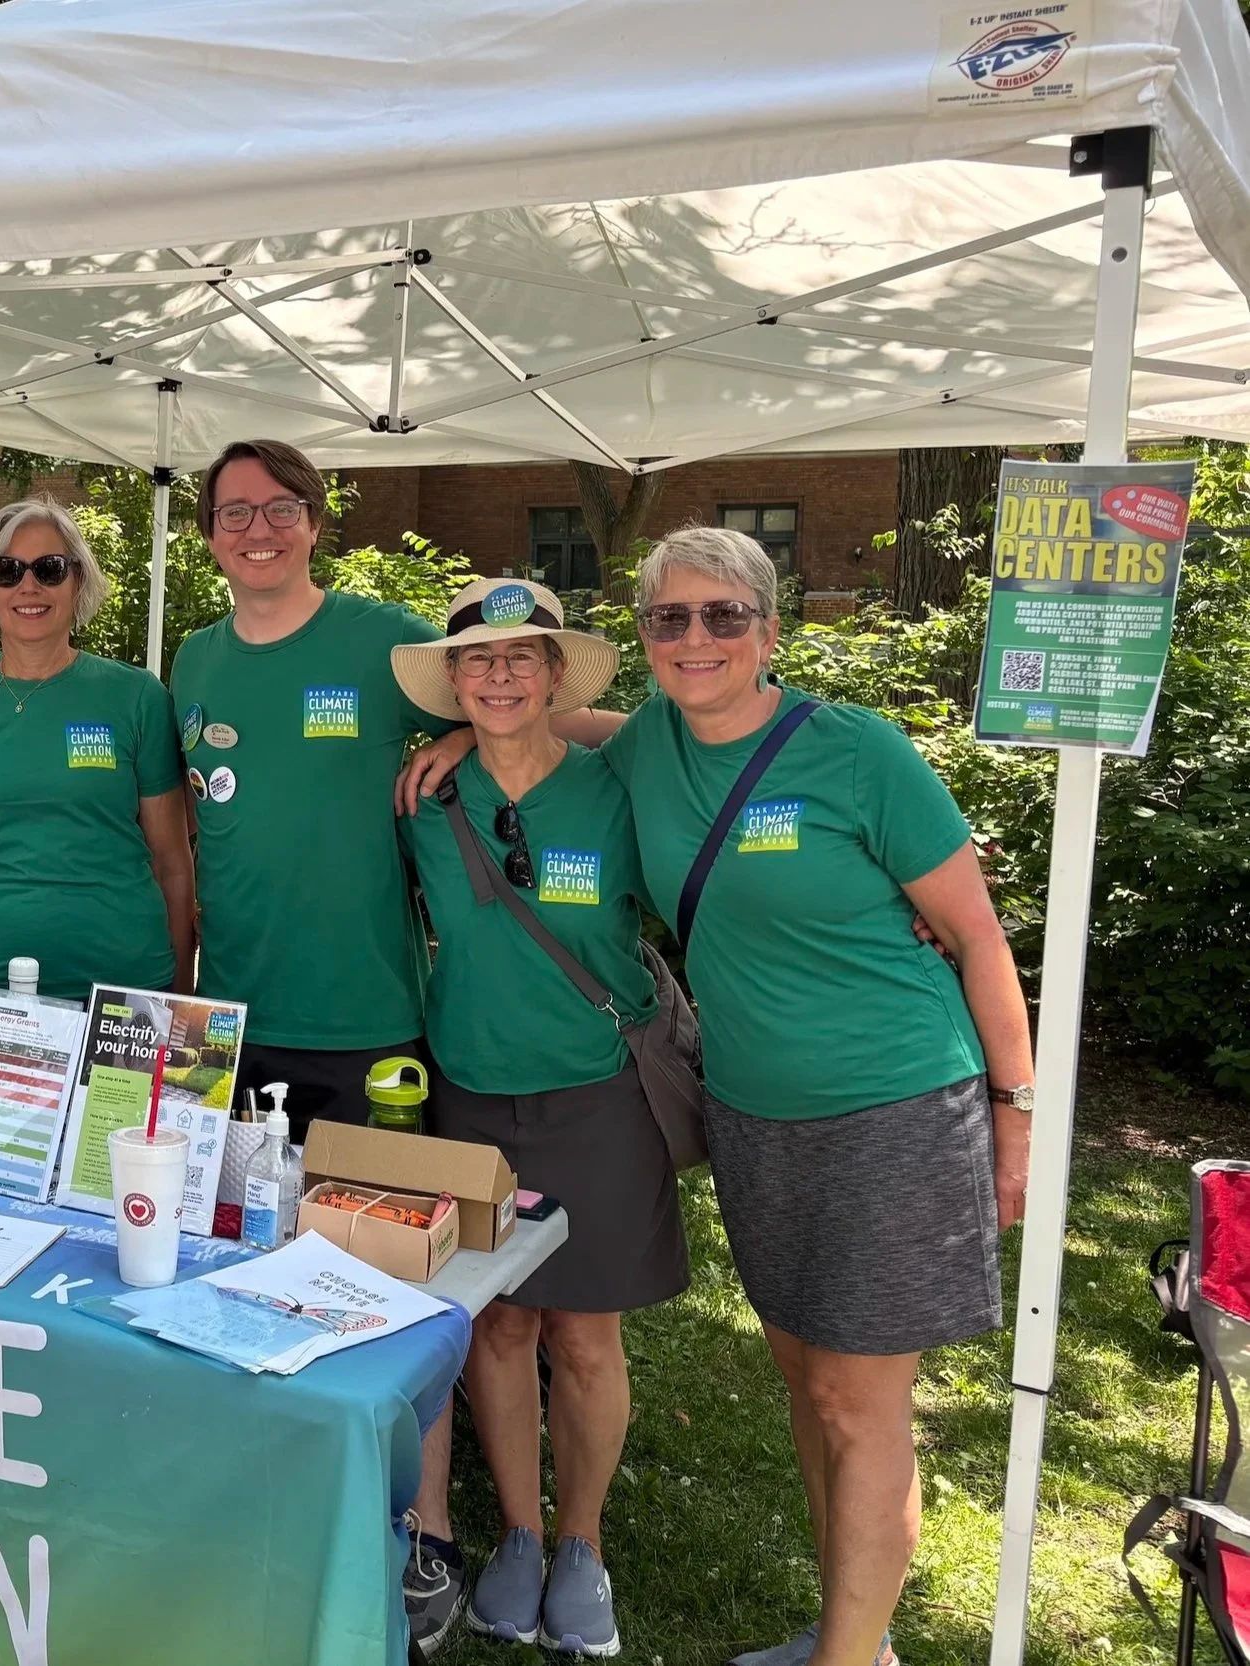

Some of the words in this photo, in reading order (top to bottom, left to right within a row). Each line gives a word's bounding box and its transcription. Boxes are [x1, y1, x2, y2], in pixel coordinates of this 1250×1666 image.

[1000, 10, 1032, 22] INSTANT
[996, 70, 1040, 87] ORIGINAL
[1004, 477, 1030, 493] LET'S
[1033, 478, 1068, 494] TALK
[1000, 495, 1092, 538] DATA
[1118, 508, 1135, 520] OUR
[995, 537, 1167, 584] CENTERS
[491, 593, 526, 608] CLIMATE
[493, 602, 527, 617] ACTION
[309, 698, 353, 710] CLIMATE
[309, 712, 354, 724] ACTION
[70, 733, 111, 744] CLIMATE
[72, 745, 112, 757] ACTION
[749, 807, 767, 815] OAK
[775, 803, 798, 812] PARK
[749, 811, 798, 829] CLIMATE
[745, 821, 793, 840] ACTION
[572, 855, 596, 863] PARK
[546, 860, 595, 876] CLIMATE
[545, 875, 594, 892] ACTION
[545, 890, 594, 899] NETWORK
[16, 1016, 40, 1028] Grants
[211, 1019, 235, 1030] CLIMATE
[99, 1020, 160, 1043] Electrify
[209, 1028, 234, 1038] ACTION
[95, 1039, 128, 1056] your
[308, 1279, 370, 1306] NATIVE
[318, 1270, 389, 1305] CHOOSE
